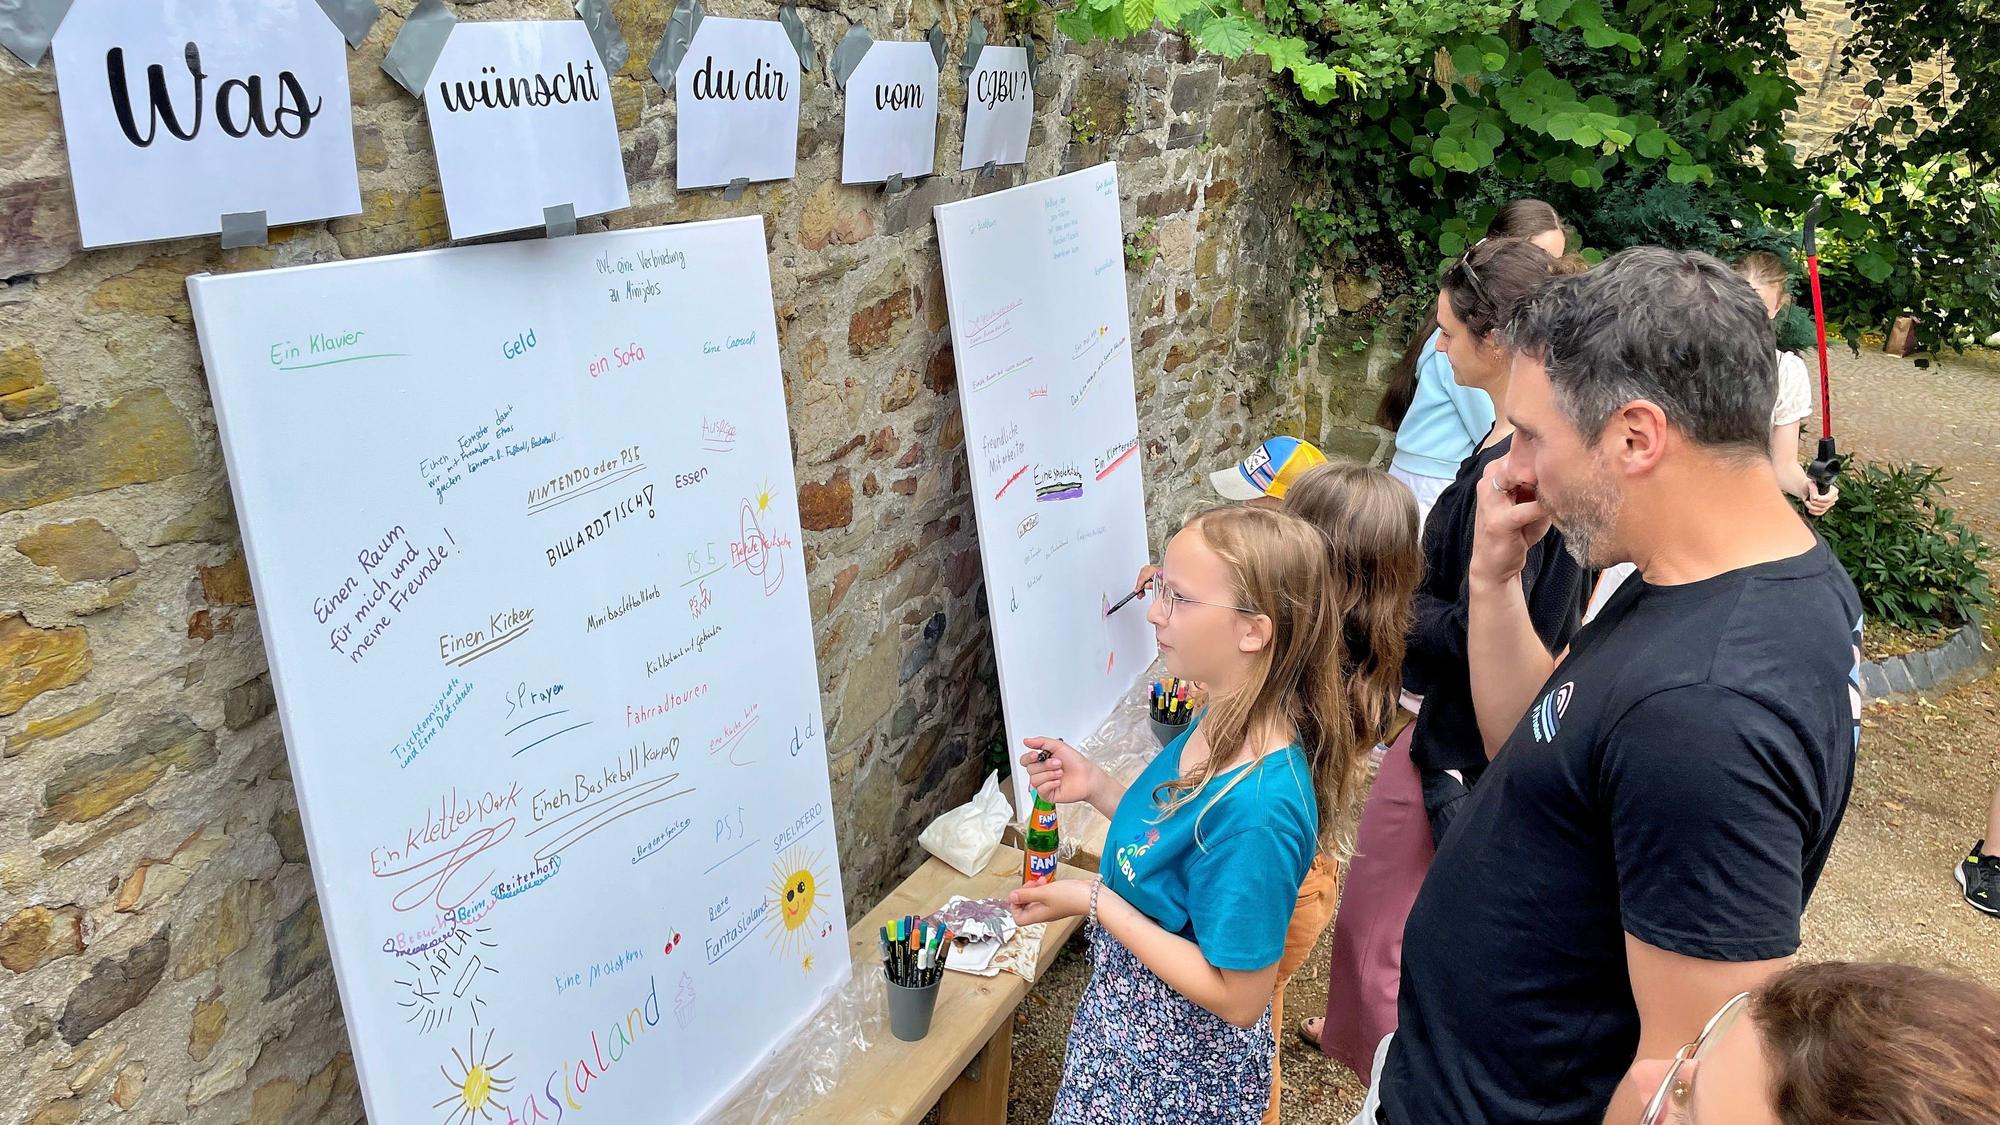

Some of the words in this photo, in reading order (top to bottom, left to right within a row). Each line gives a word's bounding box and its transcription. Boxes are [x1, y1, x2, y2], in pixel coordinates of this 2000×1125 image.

[106, 41, 322, 148] Was
[441, 59, 602, 112] wünscht
[692, 55, 741, 102] du
[744, 58, 789, 101] dir
[875, 80, 925, 112] vom
[636, 249, 686, 270] Verbindung
[270, 341, 300, 365] Ein
[309, 330, 365, 355] Klavier
[502, 328, 537, 360] Geld
[589, 354, 610, 378] ein
[613, 342, 646, 369] Sofa
[528, 467, 590, 504] NINTENDO
[594, 459, 618, 475] oder
[675, 467, 708, 488] Essen
[313, 576, 358, 624] Einen
[358, 525, 405, 574] Raum
[330, 622, 352, 654] für
[355, 578, 391, 623] mich
[391, 540, 420, 580] und
[350, 616, 391, 664] meine
[439, 631, 485, 659] Einen
[491, 608, 534, 638] Kicker
[626, 683, 708, 728] Fahrradtouren
[533, 789, 571, 822] Einen
[773, 803, 822, 851] SPIELPFERD
[371, 846, 400, 874] Ein
[705, 895, 769, 960] Fantasialand
